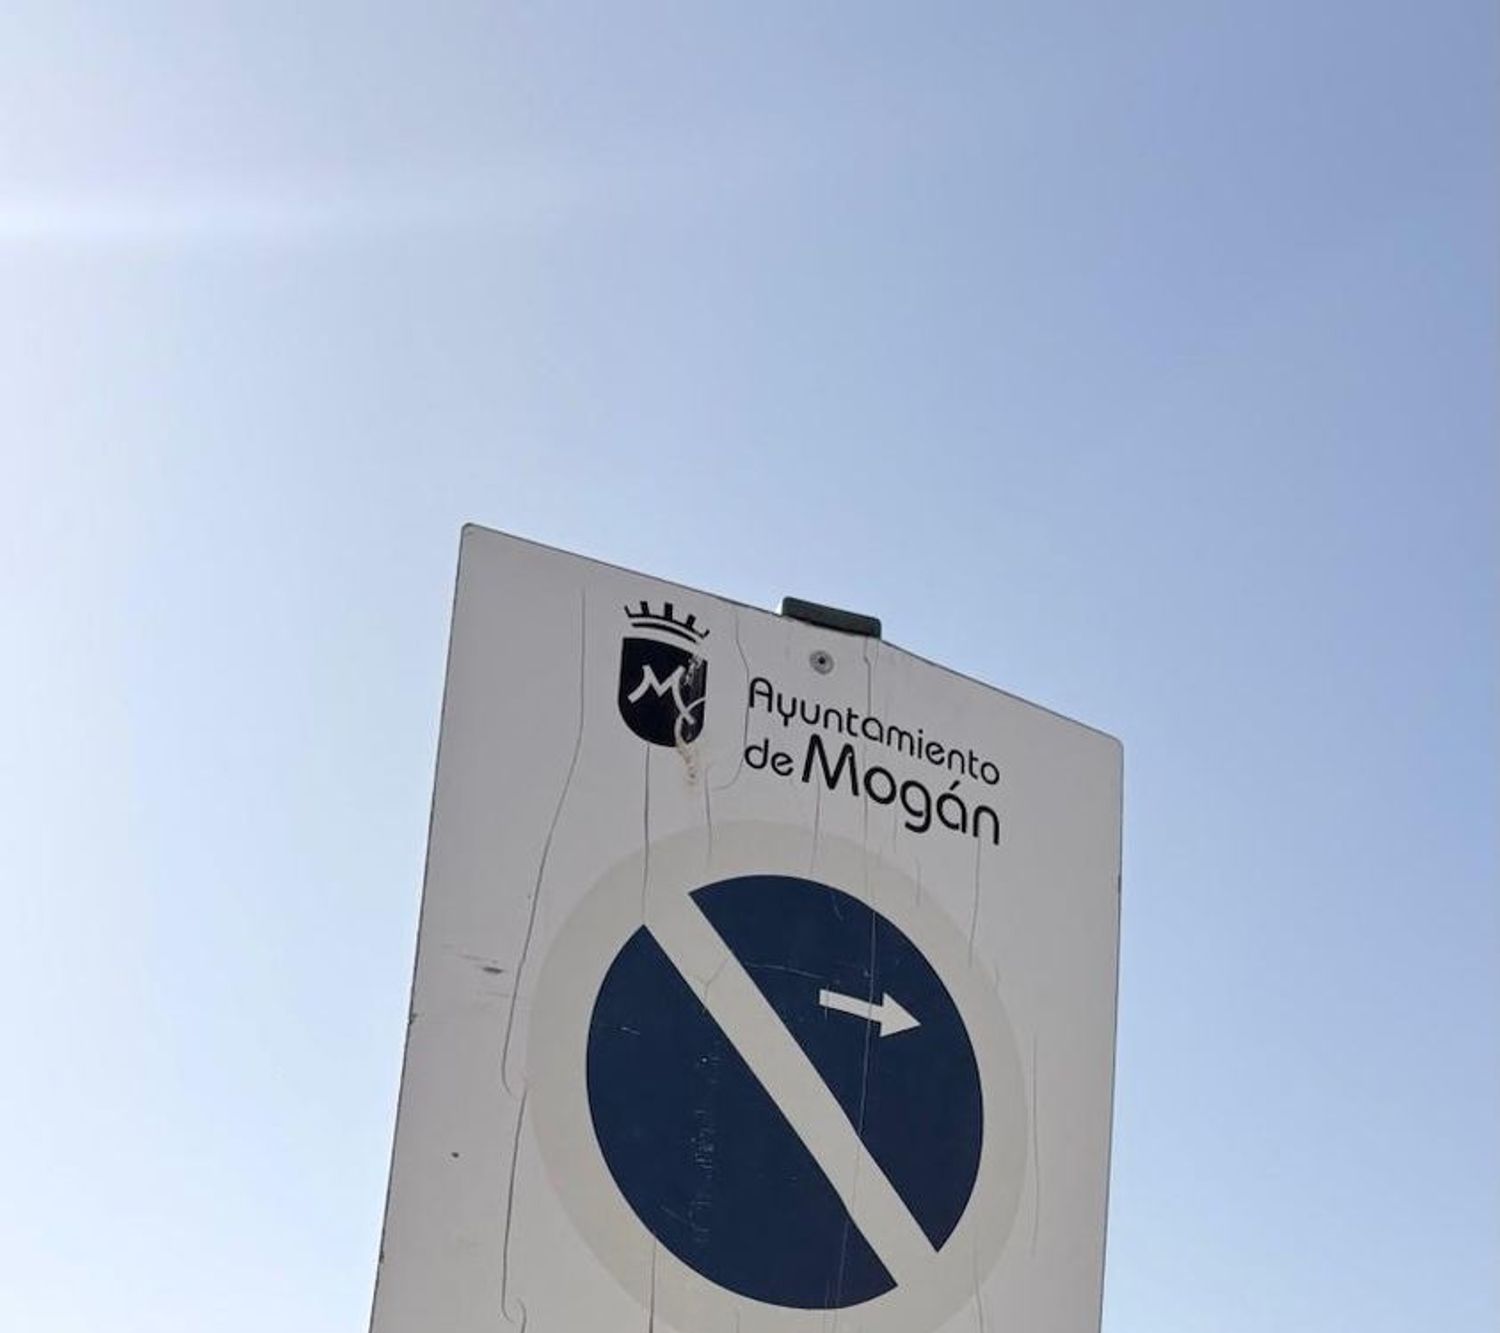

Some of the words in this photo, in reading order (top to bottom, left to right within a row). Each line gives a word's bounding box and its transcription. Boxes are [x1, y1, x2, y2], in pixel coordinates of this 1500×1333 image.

[748, 677, 999, 785] Ayuntamiento
[744, 738, 794, 777] de
[801, 733, 999, 845] Mogán
